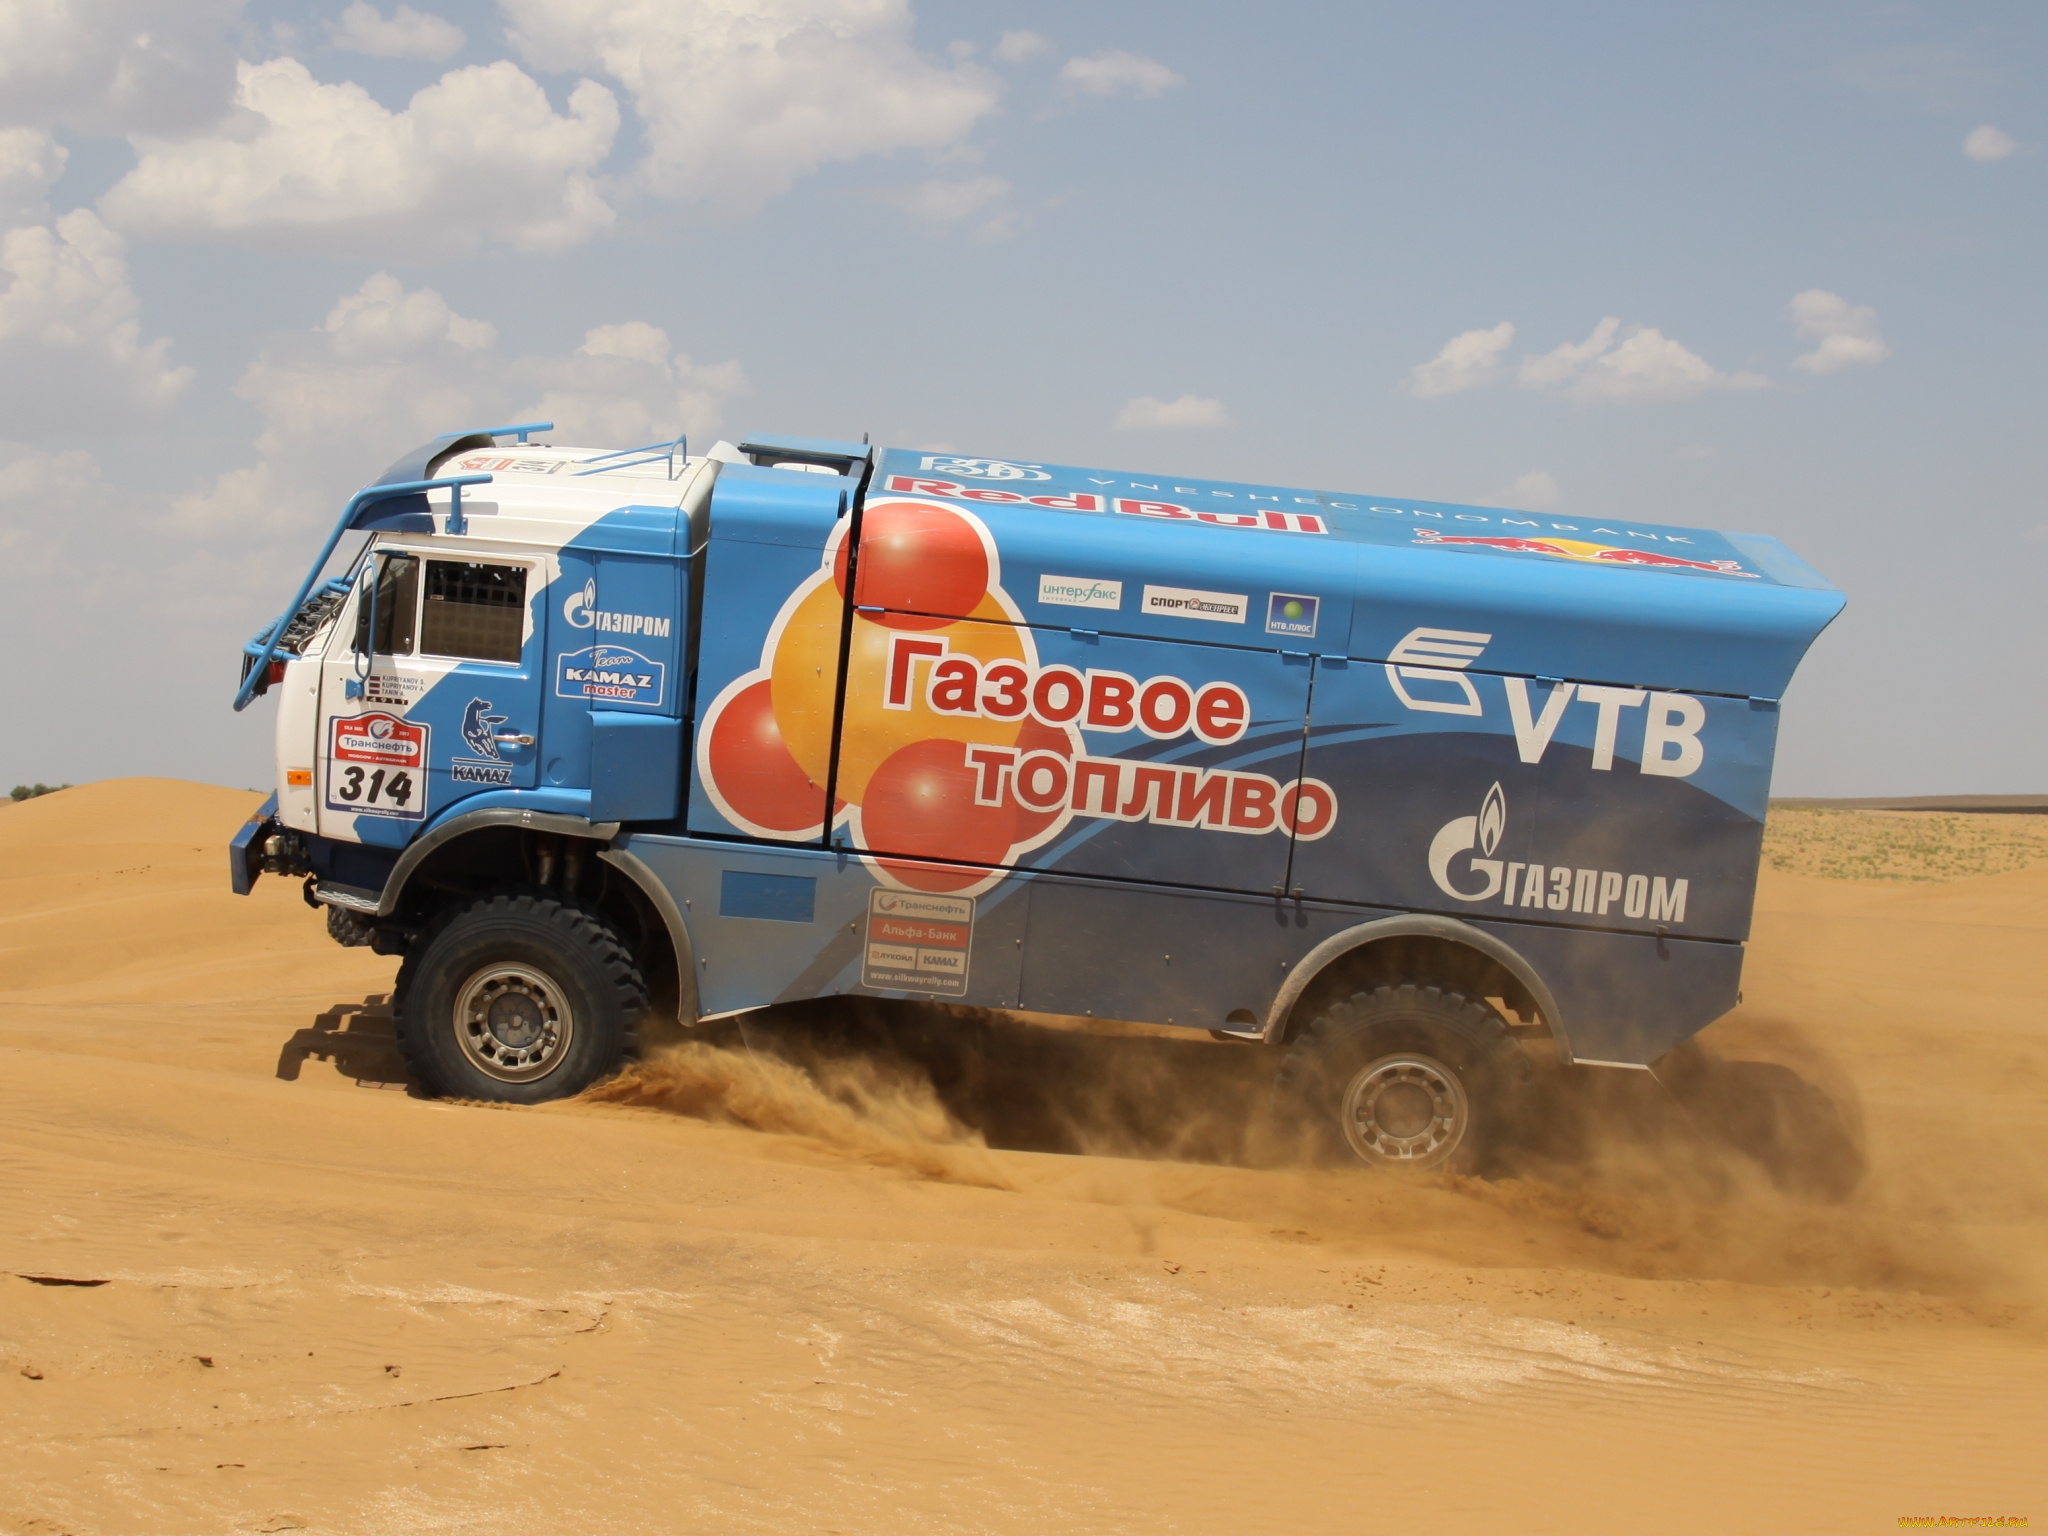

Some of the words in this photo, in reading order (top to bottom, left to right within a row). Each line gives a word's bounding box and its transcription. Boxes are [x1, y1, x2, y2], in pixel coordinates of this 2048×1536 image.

[884, 475, 1105, 512] Red
[1113, 498, 1329, 534] Bull
[1088, 477, 1696, 544] VNESHECONOMBANK
[1150, 597, 1189, 609] СПОРТ
[595, 611, 670, 637] ГАЗПРОМ
[589, 649, 633, 668] Team
[565, 668, 652, 688] KAMAZ
[583, 684, 636, 698] master
[884, 633, 1250, 745] Газовое
[1504, 676, 1706, 778] VTB
[344, 737, 413, 752] Транснефть
[453, 765, 511, 785] KAMAZ
[339, 766, 412, 807] 314
[1503, 862, 1689, 922] ГАЗПРОМ
[900, 900, 966, 914] Транснефть
[880, 951, 913, 962] ЛУКОЙЛ
[923, 955, 959, 967] KAMAZ
[870, 972, 960, 987] www.silkwayrally.com
